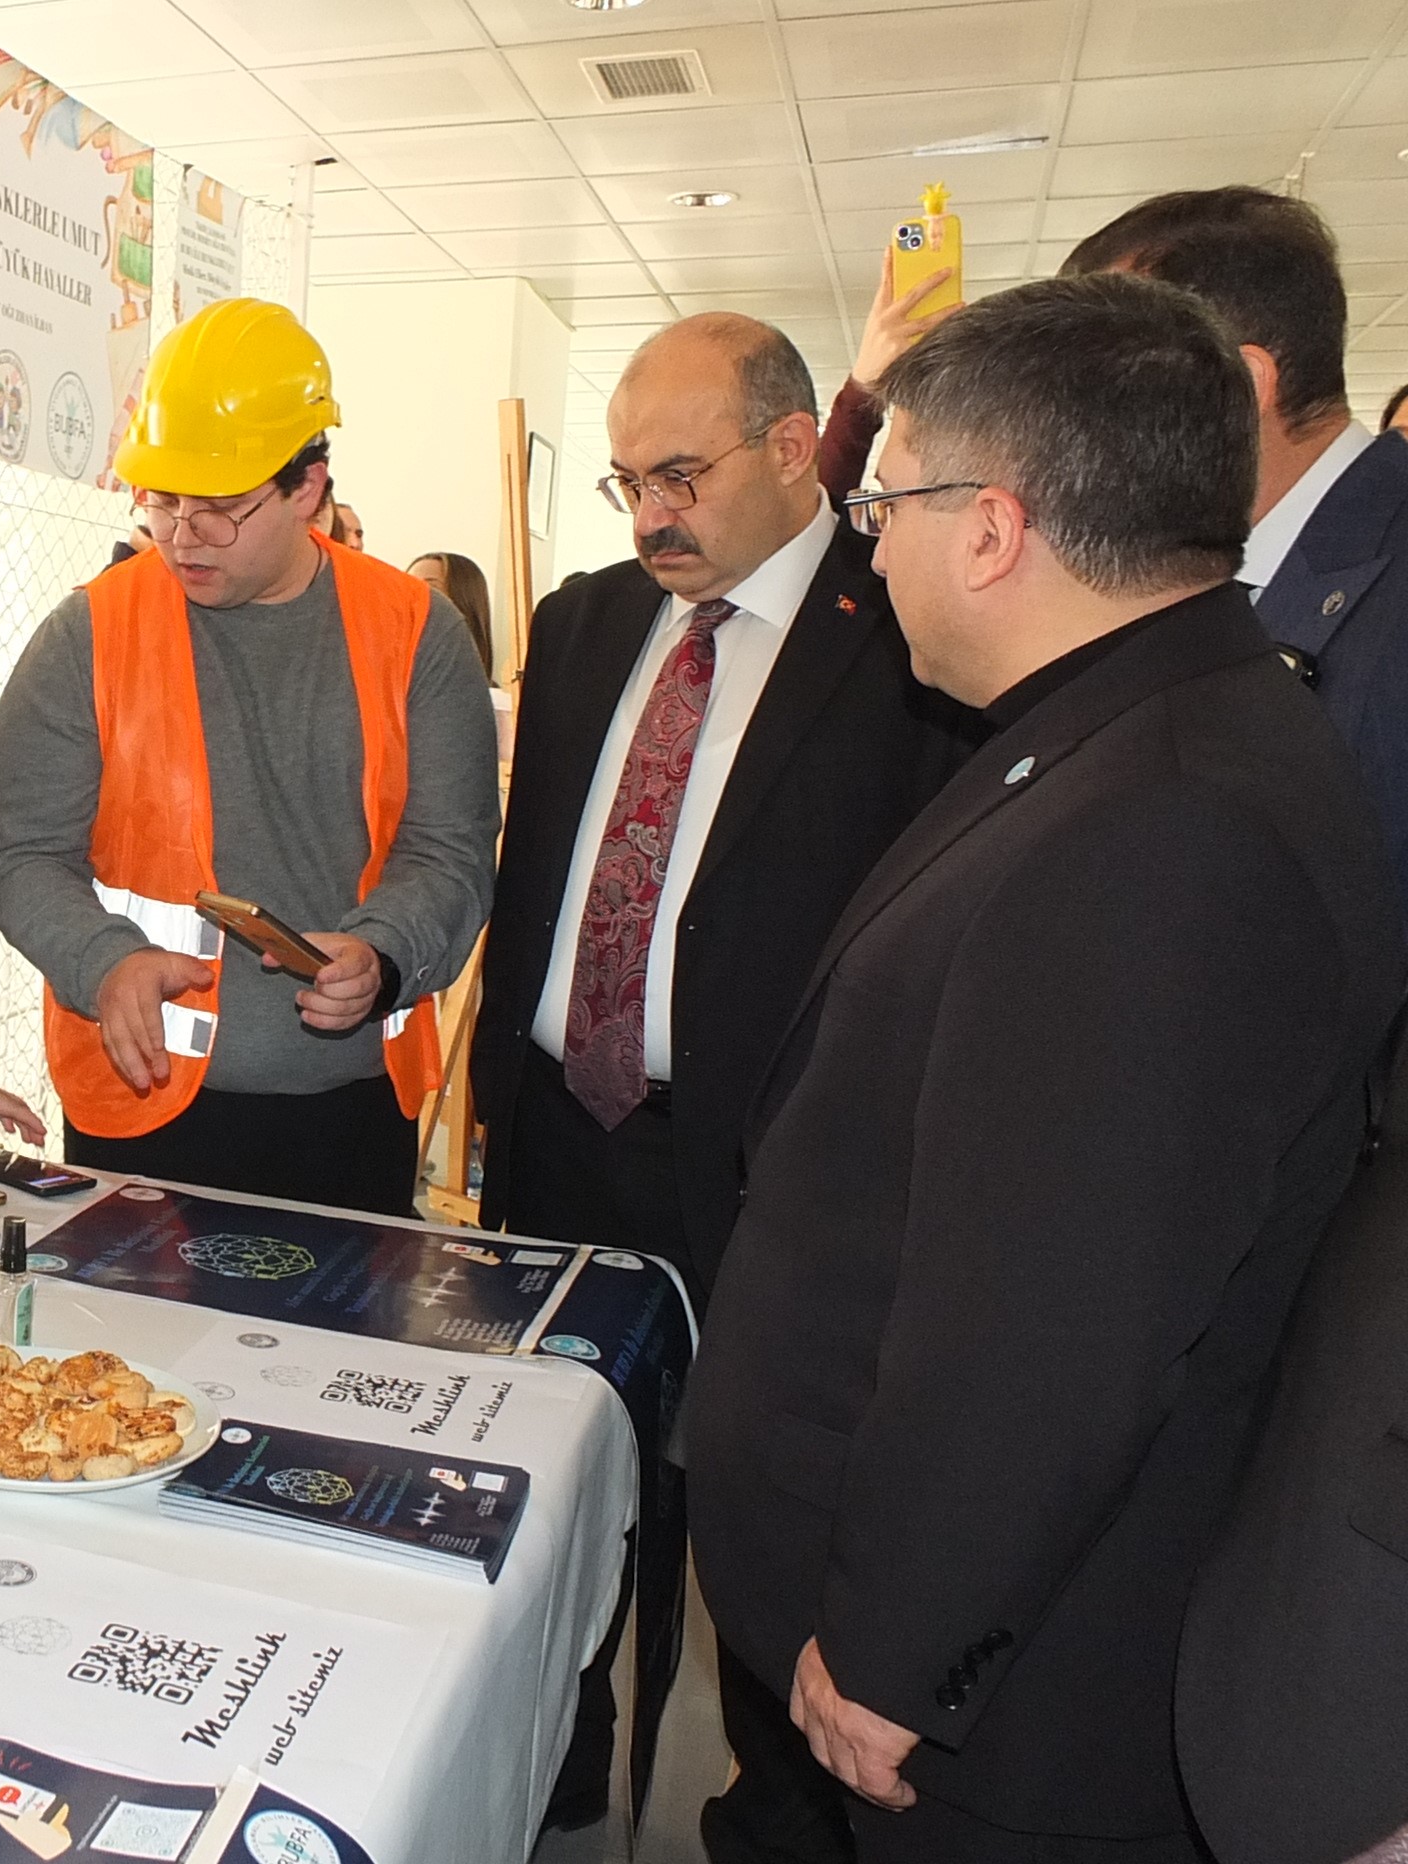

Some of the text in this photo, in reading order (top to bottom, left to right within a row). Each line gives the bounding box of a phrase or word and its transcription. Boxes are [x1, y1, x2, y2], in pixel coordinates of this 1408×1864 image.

[62, 215, 101, 256] UMUT
[33, 260, 92, 307] HAYALLER
[410, 1375, 470, 1435] Meshlink
[472, 1382, 513, 1442] web sitemiz
[181, 1633, 287, 1749] Meshlink
[265, 1646, 343, 1766] web sitemiz
